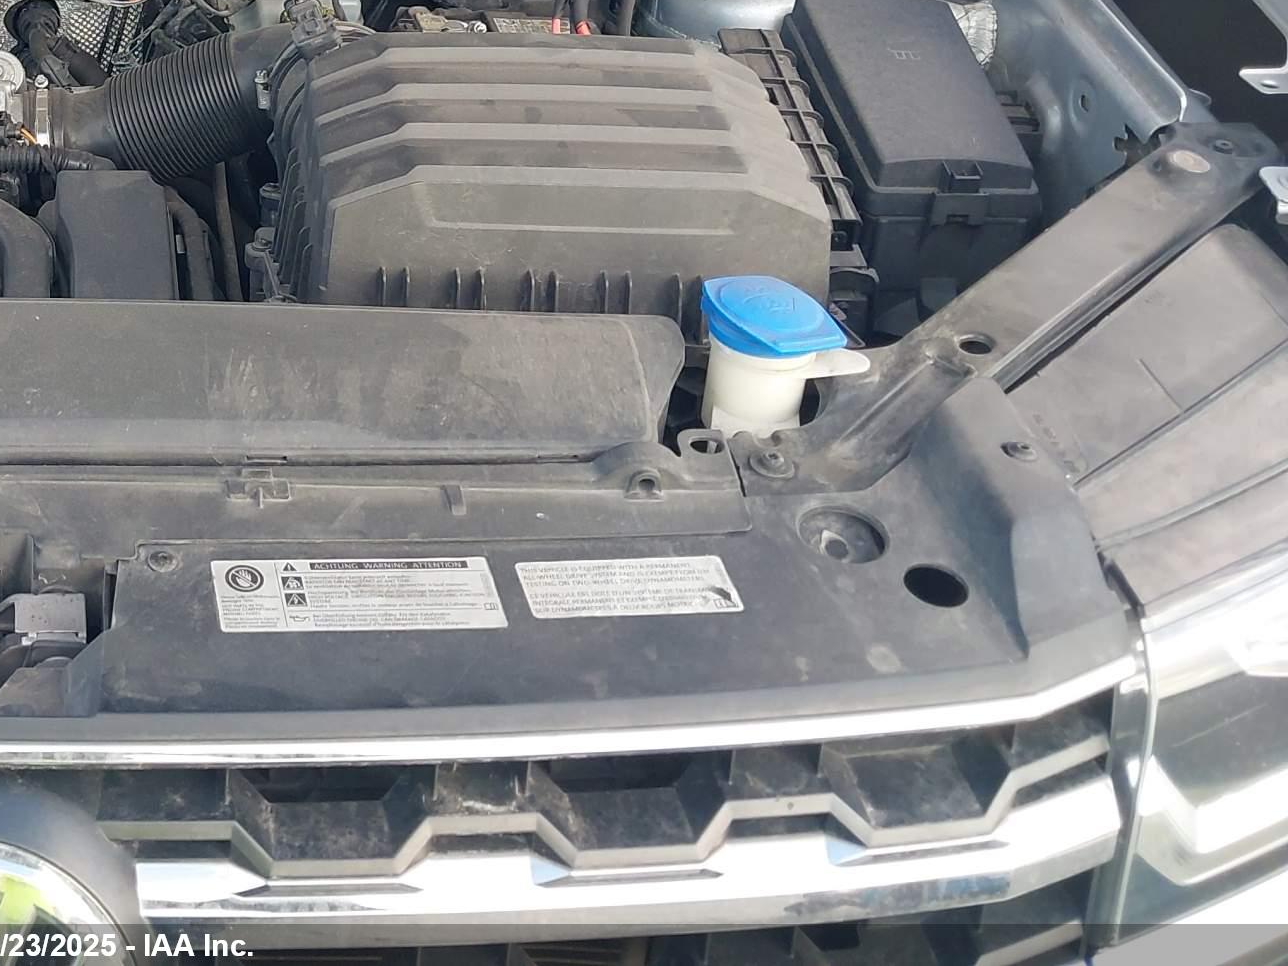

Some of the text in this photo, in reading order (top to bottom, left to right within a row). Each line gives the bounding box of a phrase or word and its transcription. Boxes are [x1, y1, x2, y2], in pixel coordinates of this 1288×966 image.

[314, 559, 462, 570] ACHTUNG WARNING ATTENTION
